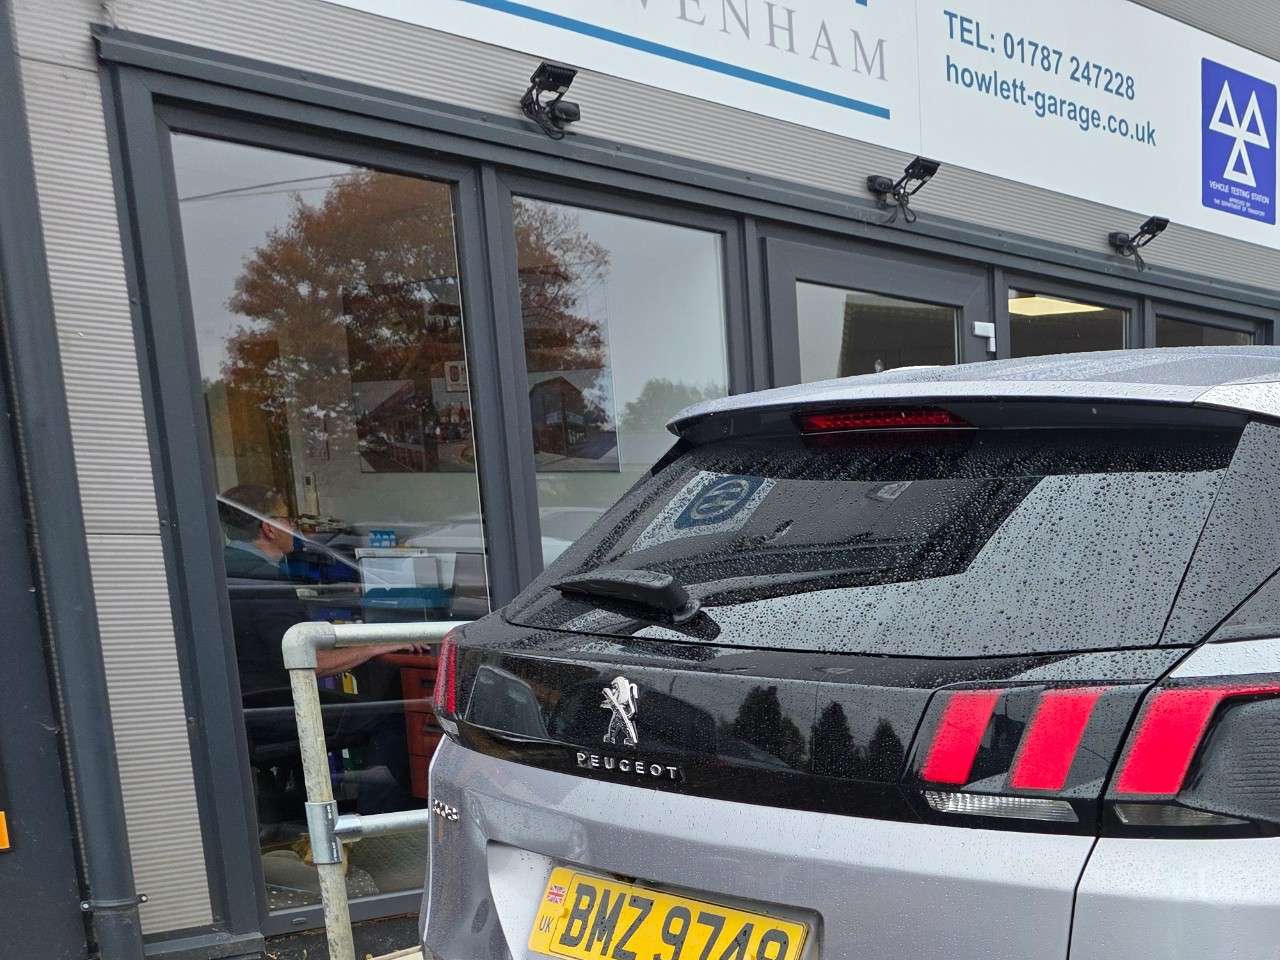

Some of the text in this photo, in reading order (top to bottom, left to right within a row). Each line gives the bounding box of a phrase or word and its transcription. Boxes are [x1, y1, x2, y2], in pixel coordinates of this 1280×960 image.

[640, 0, 889, 82] ENHAM
[944, 10, 1136, 101] TEL: 01787 247228
[946, 55, 1157, 147] howlett-garage.co.uk
[1209, 180, 1230, 193] VEHICLE
[1231, 186, 1250, 199] TESTING
[577, 752, 677, 779] PEUGEOT
[538, 914, 552, 933] UK
